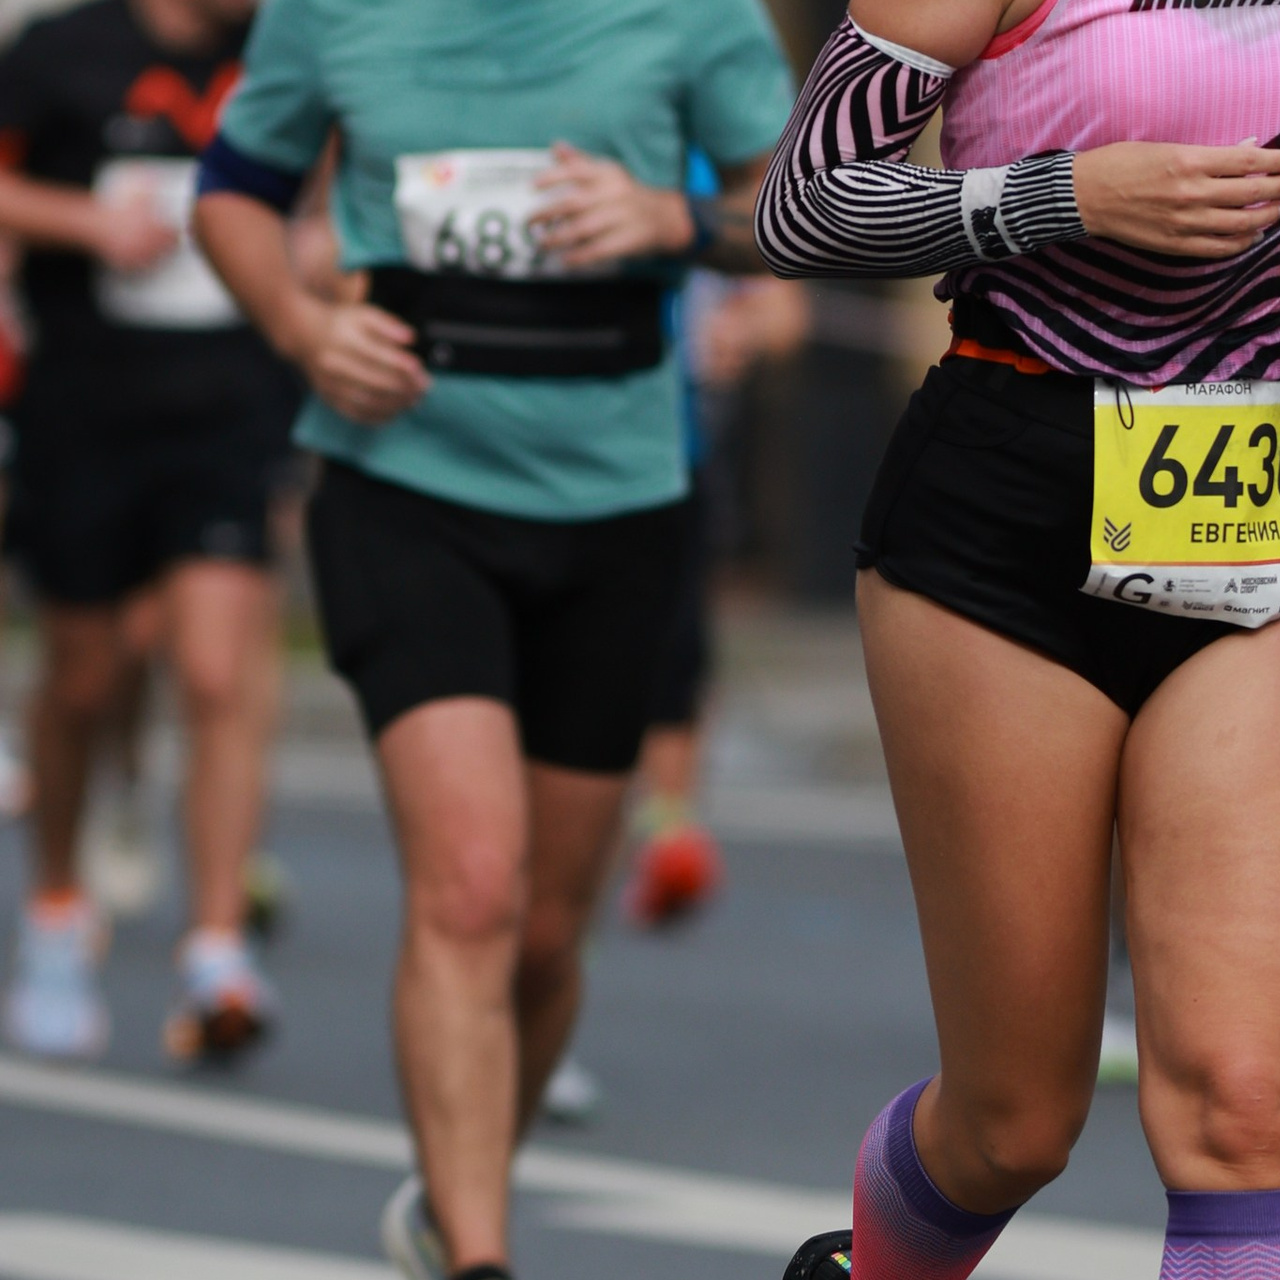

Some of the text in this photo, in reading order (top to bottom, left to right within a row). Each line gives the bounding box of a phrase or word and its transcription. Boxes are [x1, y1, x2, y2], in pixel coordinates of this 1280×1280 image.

[1185, 382, 1252, 395] МАРАФОН
[1190, 520, 1280, 543] ЕВГЕНИЯ
[1113, 572, 1155, 605] G
